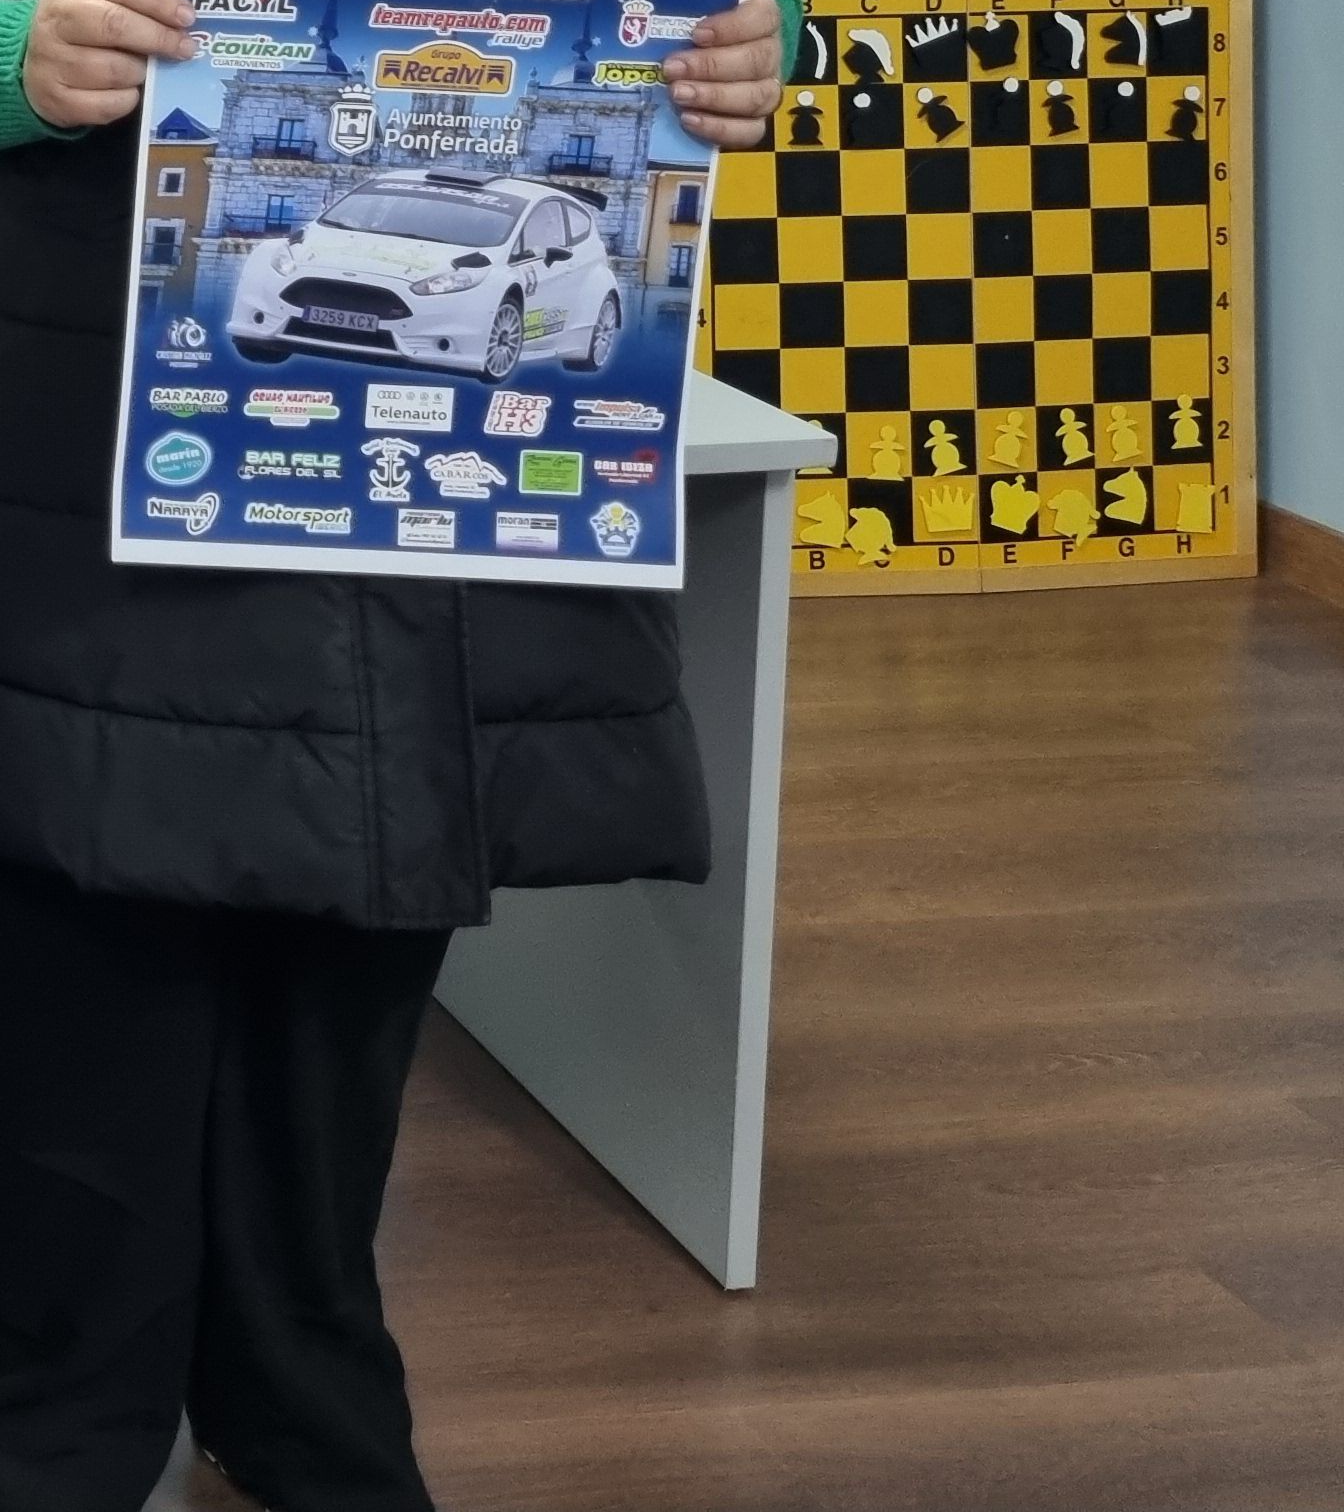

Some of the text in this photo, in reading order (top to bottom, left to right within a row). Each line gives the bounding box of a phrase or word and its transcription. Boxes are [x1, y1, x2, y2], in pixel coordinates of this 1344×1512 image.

[373, 6, 547, 33] teamrepauto.com
[494, 34, 542, 46] rallye
[1213, 32, 1226, 53] 8
[212, 43, 312, 58] COVIRAN
[432, 50, 461, 60] Grupo
[403, 61, 486, 83] Recalvi
[1215, 97, 1226, 118] 7
[388, 108, 522, 130] Ayuntamiento
[385, 129, 519, 158] Ponferrada
[1214, 162, 1227, 182] 6
[1214, 227, 1229, 247] 5
[1215, 290, 1230, 311] 4
[311, 310, 376, 330] 3259 KCX
[1216, 355, 1230, 375] 3
[153, 391, 225, 402] BAR PABLO
[503, 394, 549, 409] Bar
[372, 406, 447, 421] Telenauto
[496, 409, 541, 432] H3
[1216, 420, 1231, 440] 2
[246, 451, 341, 467] BAR FELIZ
[296, 467, 317, 477] DEL
[1219, 485, 1230, 504] 1
[249, 506, 349, 530] Motorsport
[808, 533, 1192, 571] B D E F G H
